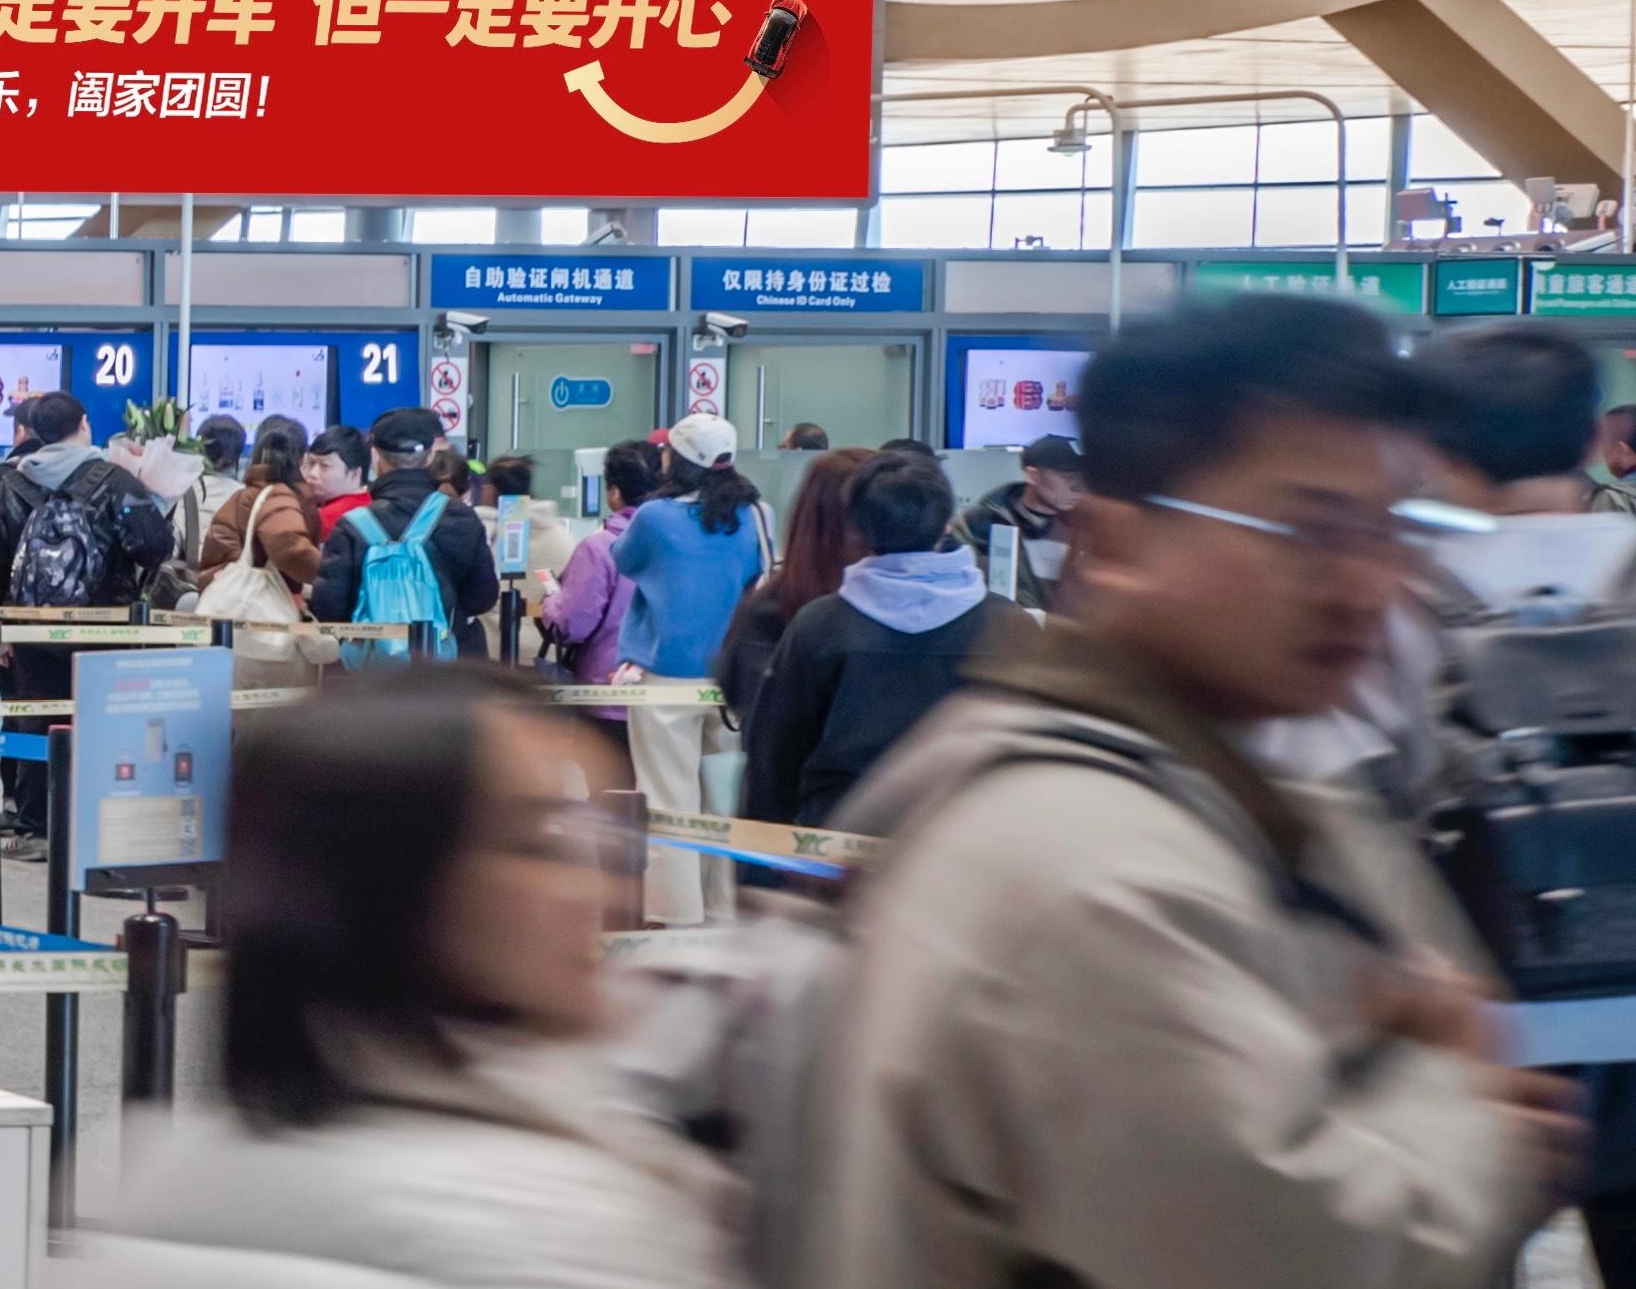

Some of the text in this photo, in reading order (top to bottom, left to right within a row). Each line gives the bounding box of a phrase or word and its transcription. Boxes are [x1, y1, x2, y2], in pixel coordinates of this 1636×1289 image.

[464, 266, 635, 291] 自助验证闸机通道
[722, 268, 892, 293] 仅限持身份证过检
[497, 292, 603, 306] Automatic Gateway
[756, 294, 856, 308] Chinese ID Card Only
[95, 344, 134, 385] 20
[362, 343, 399, 384] 21
